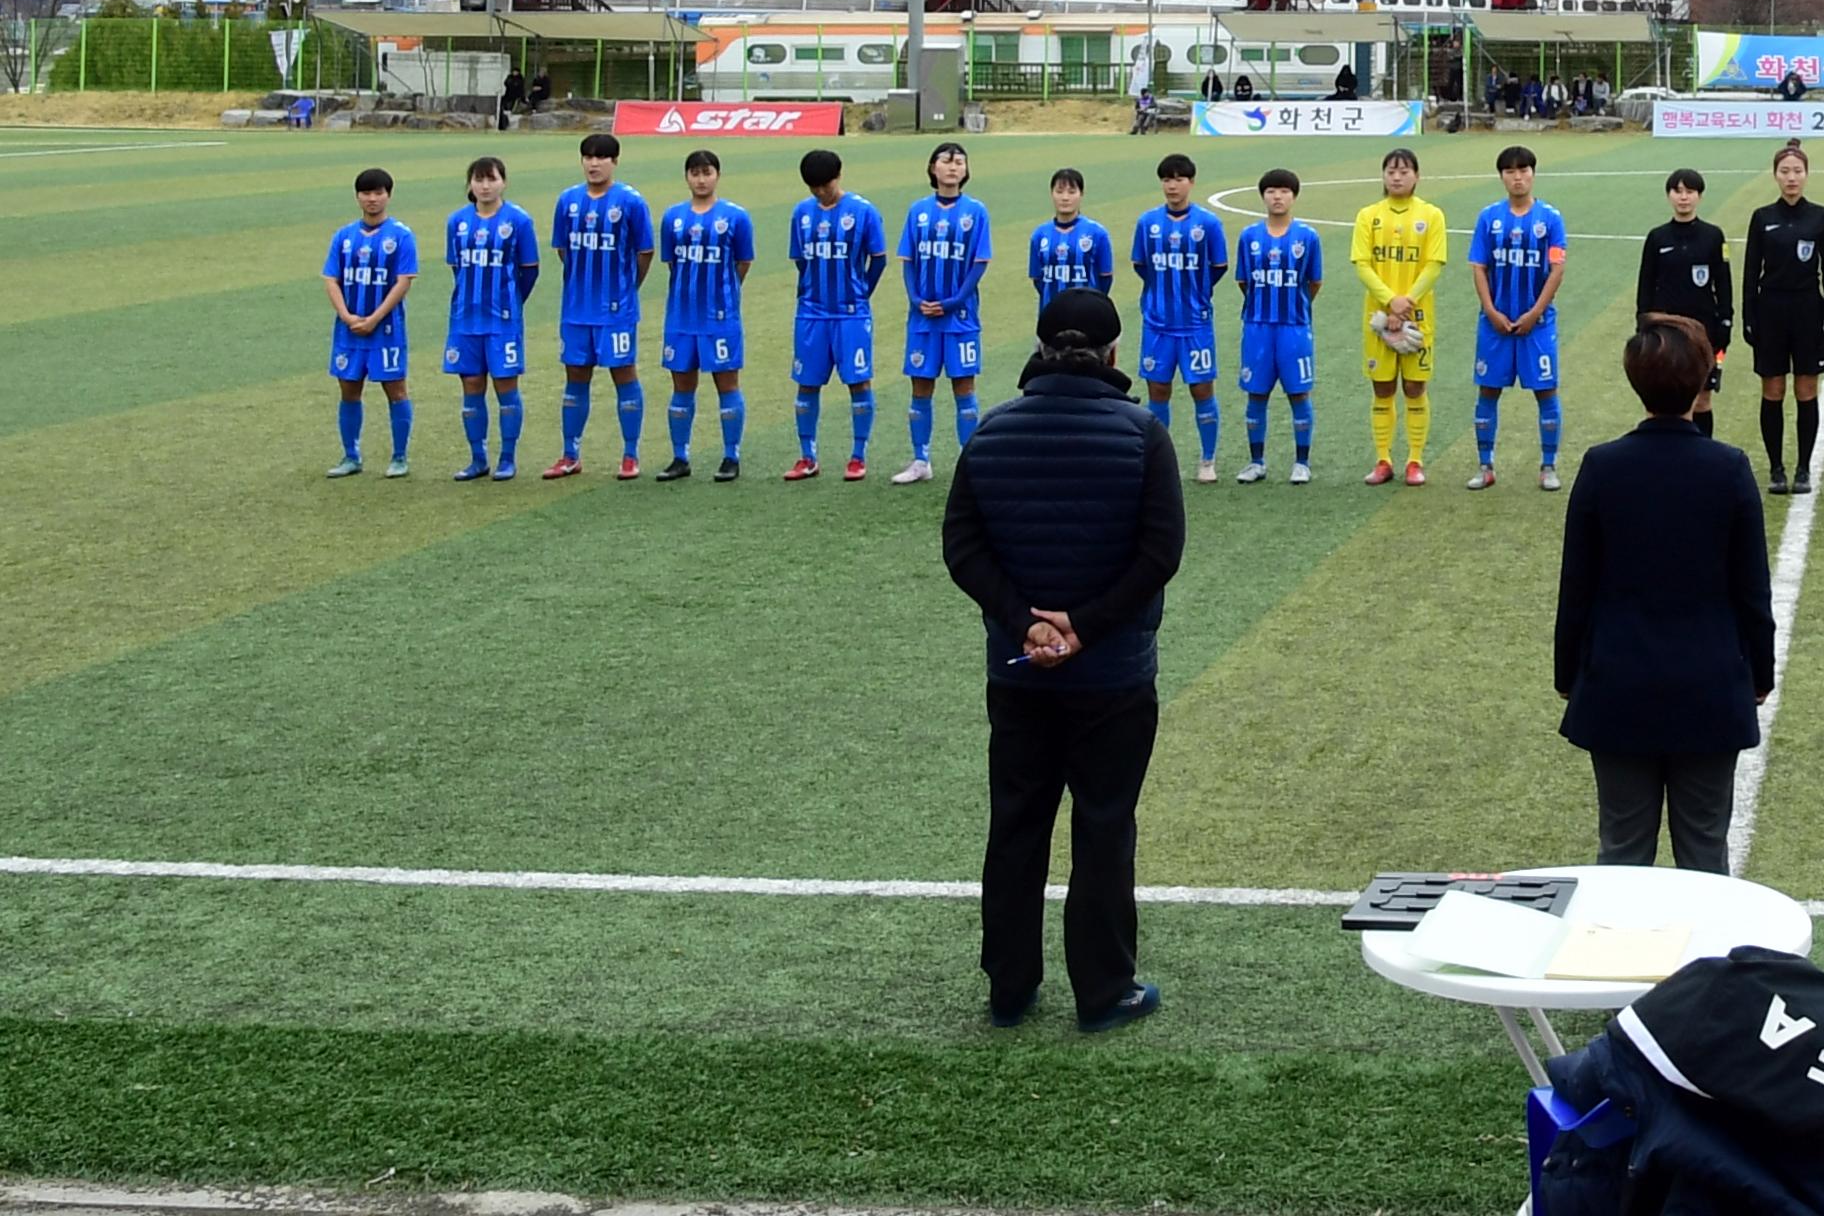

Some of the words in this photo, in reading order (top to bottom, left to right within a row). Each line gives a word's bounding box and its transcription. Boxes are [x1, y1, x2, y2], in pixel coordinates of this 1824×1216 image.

[1662, 111, 1758, 130] 행복교육도시
[1766, 111, 1803, 130] 화천
[918, 240, 965, 261] 현대고
[1151, 252, 1199, 271] 현대고
[1372, 245, 1420, 263] 현대고
[1492, 248, 1541, 267] 현대고
[1252, 269, 1299, 288] 현대고
[504, 341, 517, 364] 5
[612, 332, 630, 354] 18
[715, 338, 728, 360] 6
[958, 341, 977, 365] 16
[381, 346, 400, 368] 17
[854, 347, 867, 368] 4
[1190, 348, 1212, 372] 20
[1298, 356, 1312, 380] 11
[1539, 354, 1551, 377] 9
